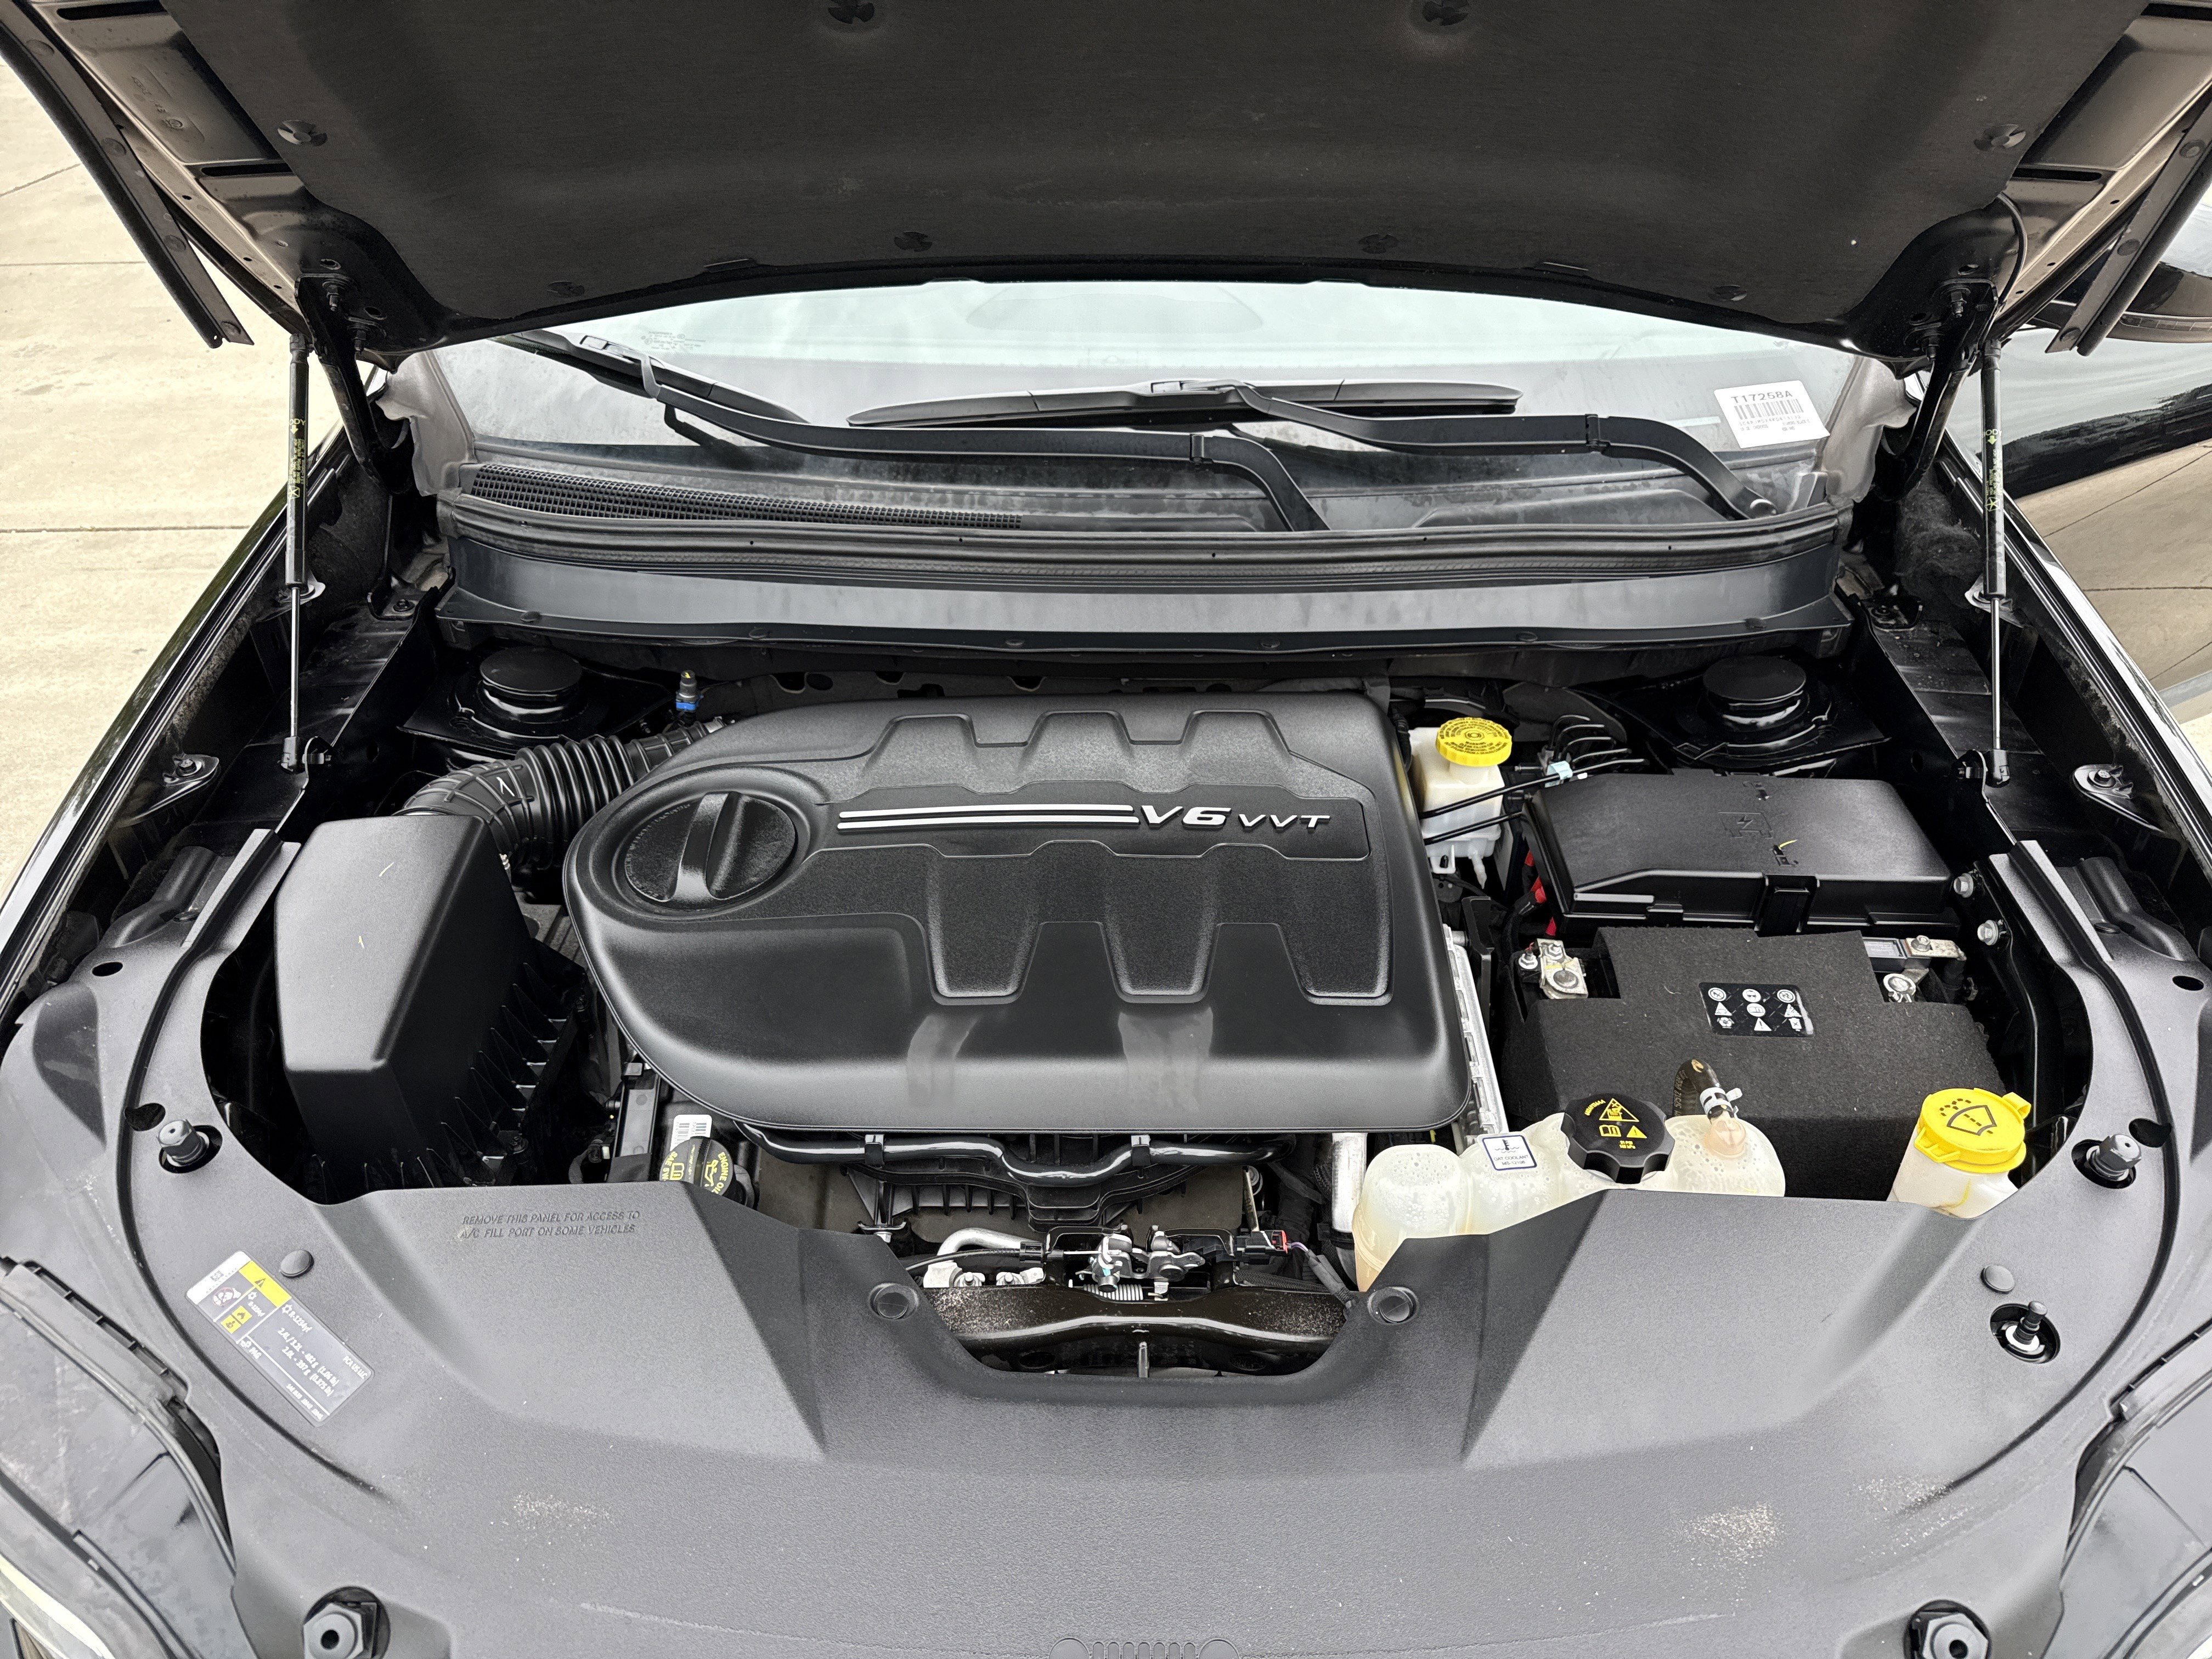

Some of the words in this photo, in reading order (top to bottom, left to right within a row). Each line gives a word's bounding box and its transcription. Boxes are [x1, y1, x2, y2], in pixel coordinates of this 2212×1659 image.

[1731, 391, 1793, 403] T17258A
[1141, 804, 1232, 829] V6
[1238, 814, 1331, 832] VVT
[665, 1151, 678, 1167] SAE
[718, 1152, 729, 1182] ENGINE
[712, 1182, 724, 1194] OIL
[462, 1214, 504, 1224] REMOVE
[505, 1214, 528, 1223] THIS
[530, 1212, 562, 1223] PANEL
[564, 1212, 584, 1222] FOR
[586, 1211, 625, 1221] ACCESS
[627, 1210, 640, 1220] TO
[484, 1227, 505, 1238] FILL
[507, 1227, 535, 1237] PORT
[538, 1226, 552, 1236] ON
[555, 1225, 585, 1235] SOME
[588, 1224, 636, 1234] VEHICLES
[289, 1311, 313, 1333] R-1234yf
[249, 1347, 262, 1359] PAG
[342, 1355, 353, 1367] FCA
[351, 1363, 360, 1373] US
[357, 1369, 368, 1380] LLC
